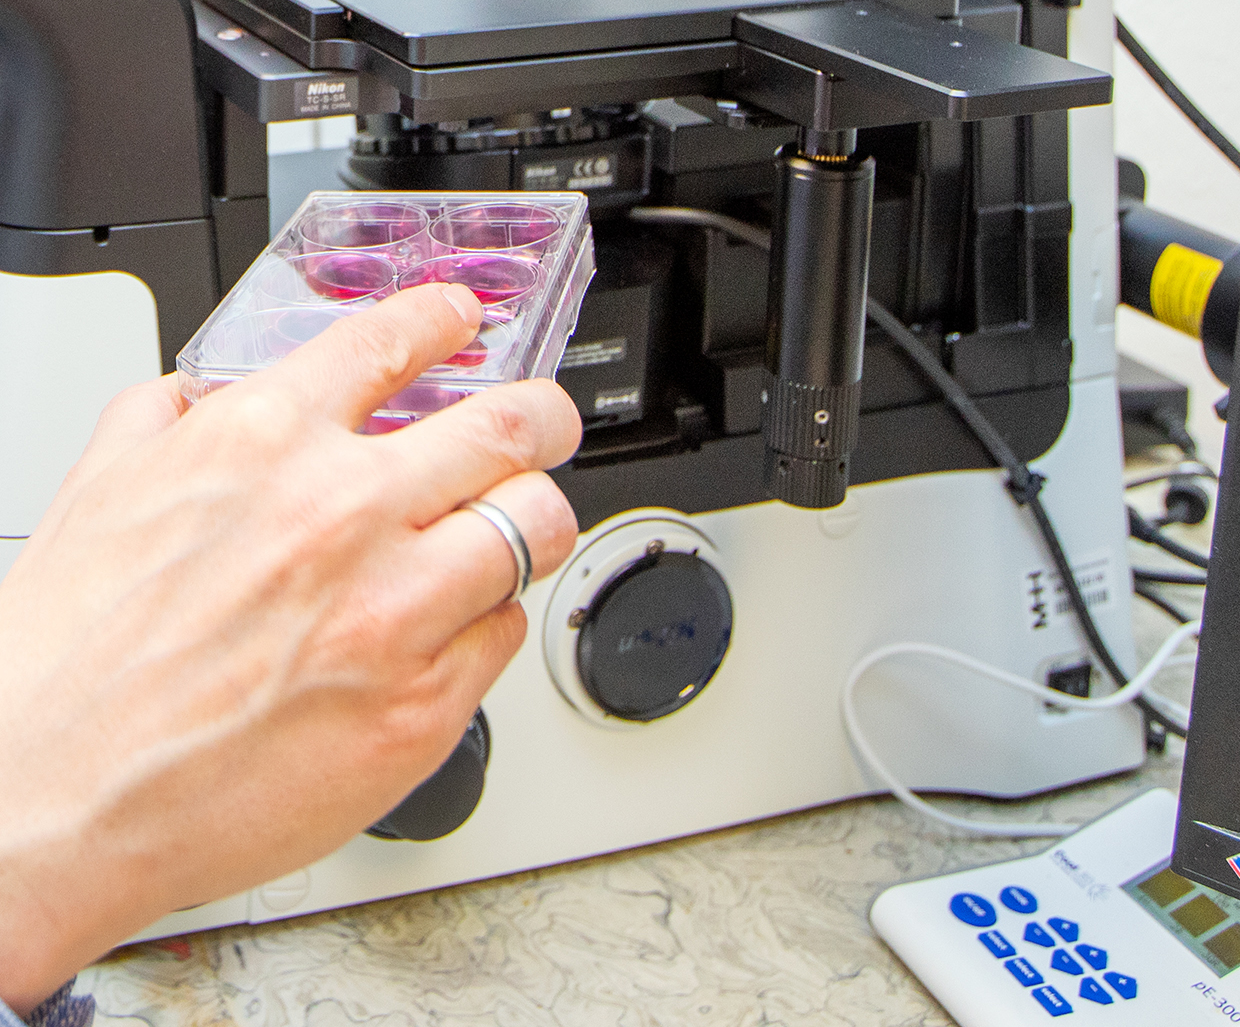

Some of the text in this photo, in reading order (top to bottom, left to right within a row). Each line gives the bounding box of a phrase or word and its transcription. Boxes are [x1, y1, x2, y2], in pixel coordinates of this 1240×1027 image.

[307, 82, 345, 96] Nikon
[1014, 959, 1035, 978] select
[1041, 987, 1063, 1008] select
